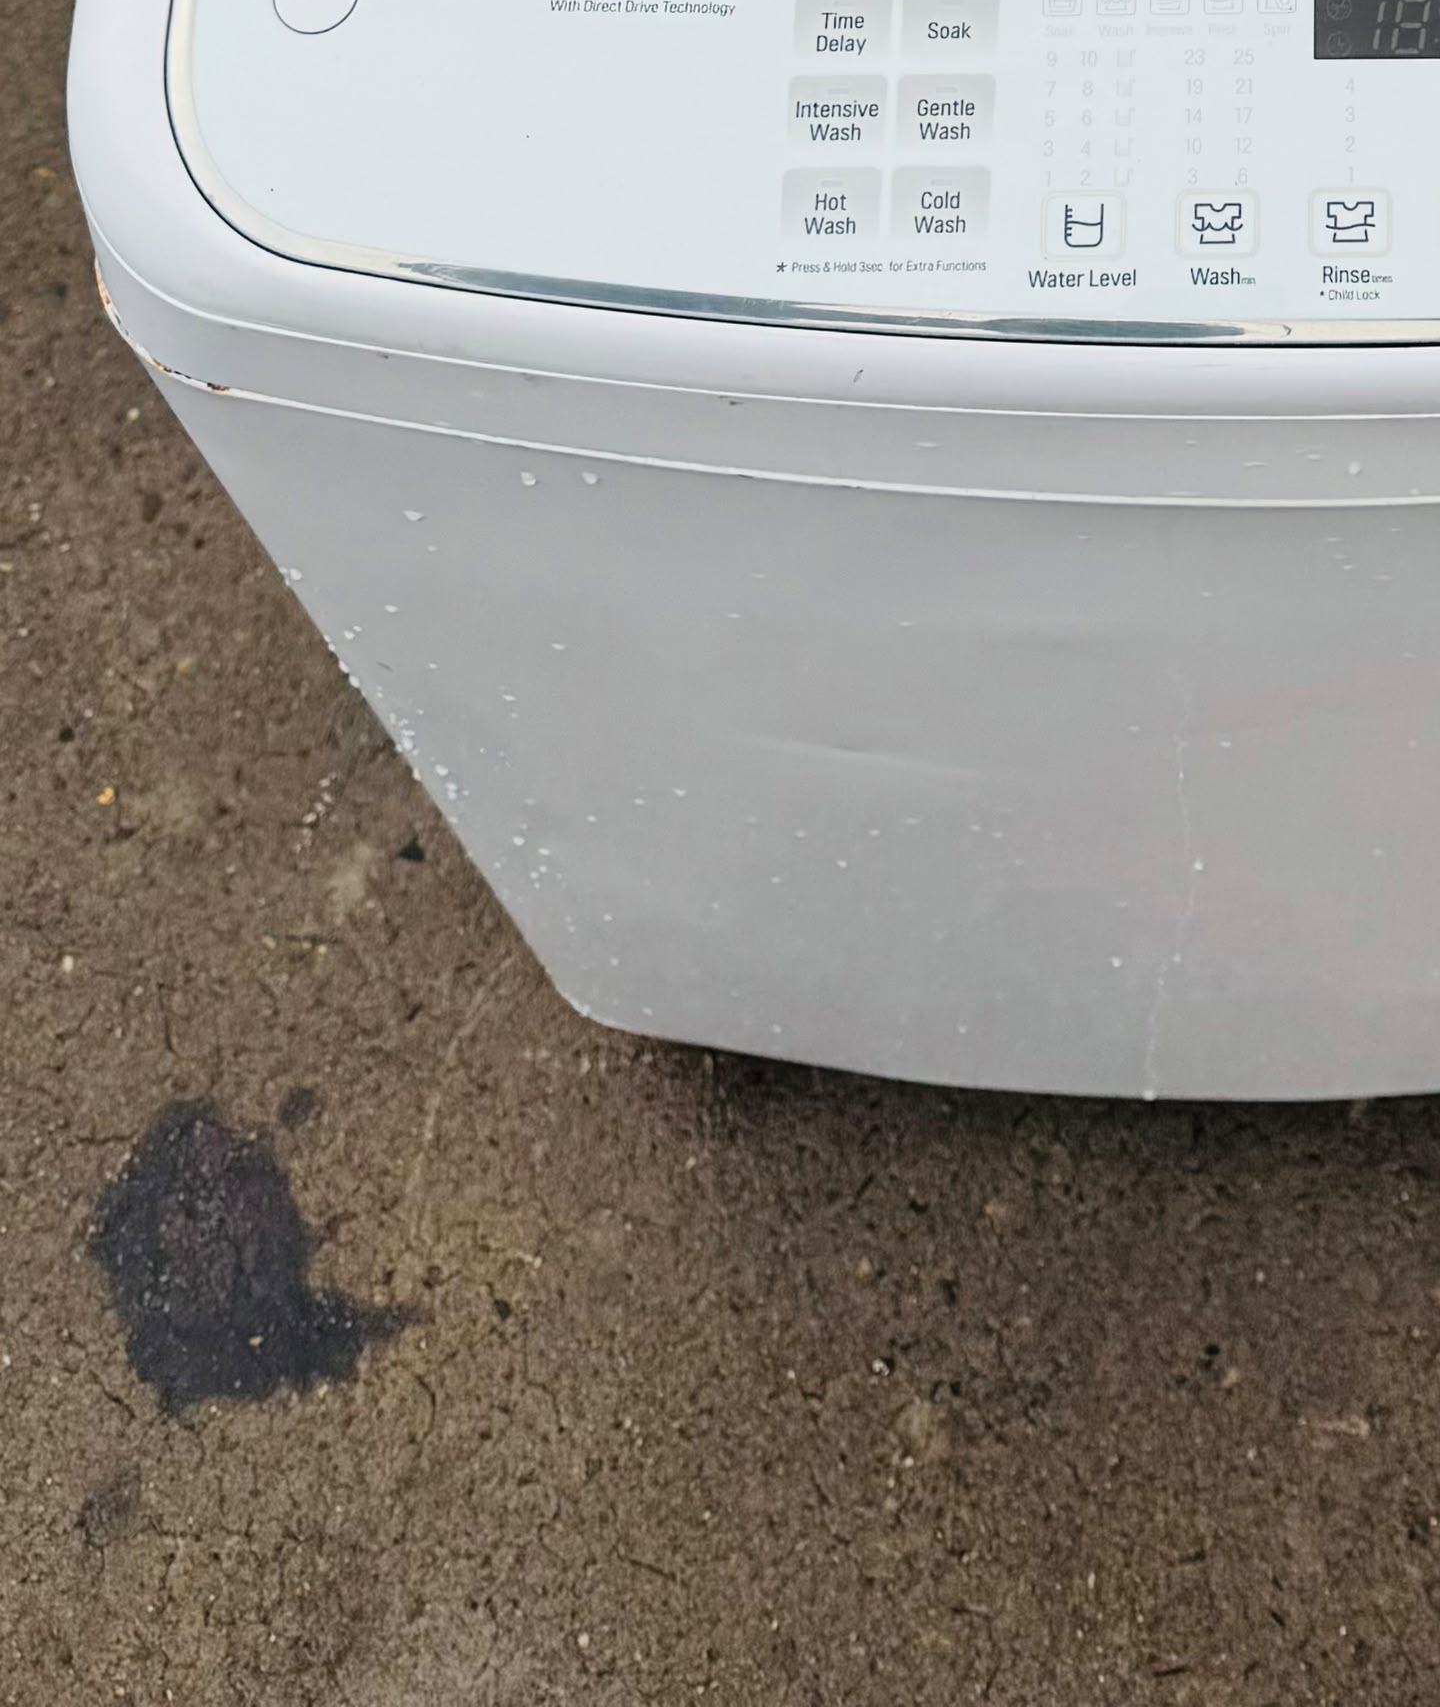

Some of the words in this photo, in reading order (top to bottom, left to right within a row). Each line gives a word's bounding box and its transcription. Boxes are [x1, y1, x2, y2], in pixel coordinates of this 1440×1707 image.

[550, 0, 580, 12] With
[583, 0, 622, 13] Direct
[625, 0, 659, 13] Drive
[663, 0, 736, 17] Technology
[821, 12, 865, 30] Time
[927, 21, 972, 40] Soak
[816, 35, 867, 56] Delay
[1046, 50, 1057, 67] 9
[1081, 50, 1098, 67] 10
[1184, 48, 1206, 66] 23
[1233, 48, 1255, 66] 25
[1046, 80, 1057, 98] 7
[1082, 79, 1094, 97] 8
[1186, 77, 1203, 95] 19
[1235, 77, 1253, 95] 21
[1344, 77, 1355, 93] 4
[795, 100, 879, 119] Intensive
[916, 99, 976, 118] Gentle
[1185, 107, 1202, 123] 14
[1235, 107, 1253, 123] 17
[1344, 106, 1356, 123] 3
[1044, 109, 1055, 127] 5
[1081, 109, 1092, 127] 6
[809, 124, 862, 142] Wash
[918, 122, 971, 141] Wash
[1043, 139, 1054, 157] 3
[1080, 139, 1091, 156] 4
[1186, 138, 1202, 155] 10
[1236, 138, 1253, 155] 12
[1344, 135, 1356, 153] 2
[1080, 169, 1091, 186] 2
[1187, 167, 1198, 184] 3
[1237, 167, 1248, 184] 6
[814, 193, 847, 212] Hot
[920, 191, 960, 210] Cold
[804, 217, 856, 236] Wash
[914, 215, 967, 234] Wash
[792, 261, 820, 273] Press
[833, 261, 857, 273] Hold
[889, 260, 903, 272] for
[906, 260, 934, 272] Extra
[936, 259, 987, 272] Functions
[1028, 269, 1085, 288] Water
[1089, 268, 1137, 287] Level
[1328, 289, 1354, 300] Child
[1356, 289, 1381, 300] Lock
